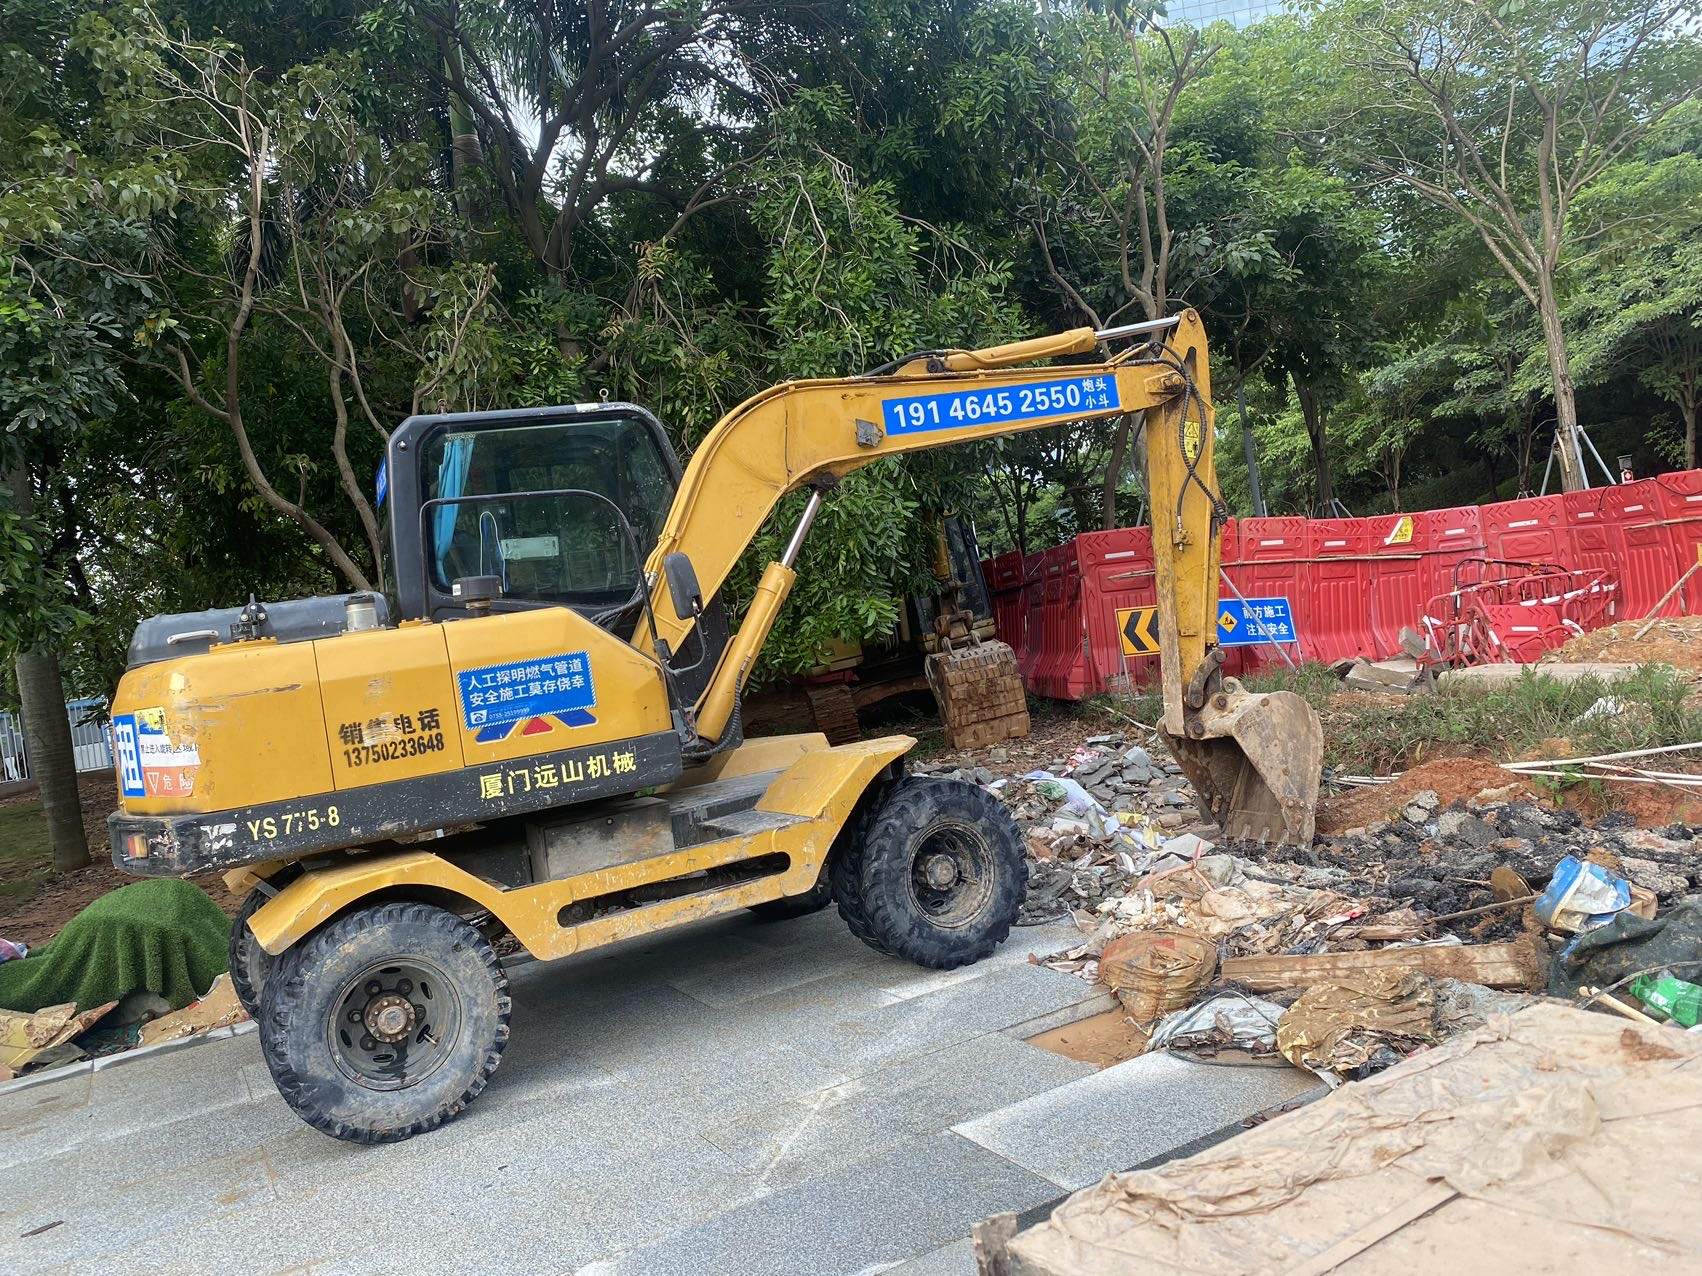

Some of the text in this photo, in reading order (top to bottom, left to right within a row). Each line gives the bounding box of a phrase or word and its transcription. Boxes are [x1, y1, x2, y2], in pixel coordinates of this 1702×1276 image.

[893, 384, 1081, 428] 191 4645 2550
[1086, 393, 1109, 408] 小斗
[468, 658, 583, 690] 人工探明燃气管道
[470, 675, 585, 707] 安全施工莫存侥幸
[344, 733, 445, 768] 13750233648
[479, 751, 637, 799] 厦门远山机械
